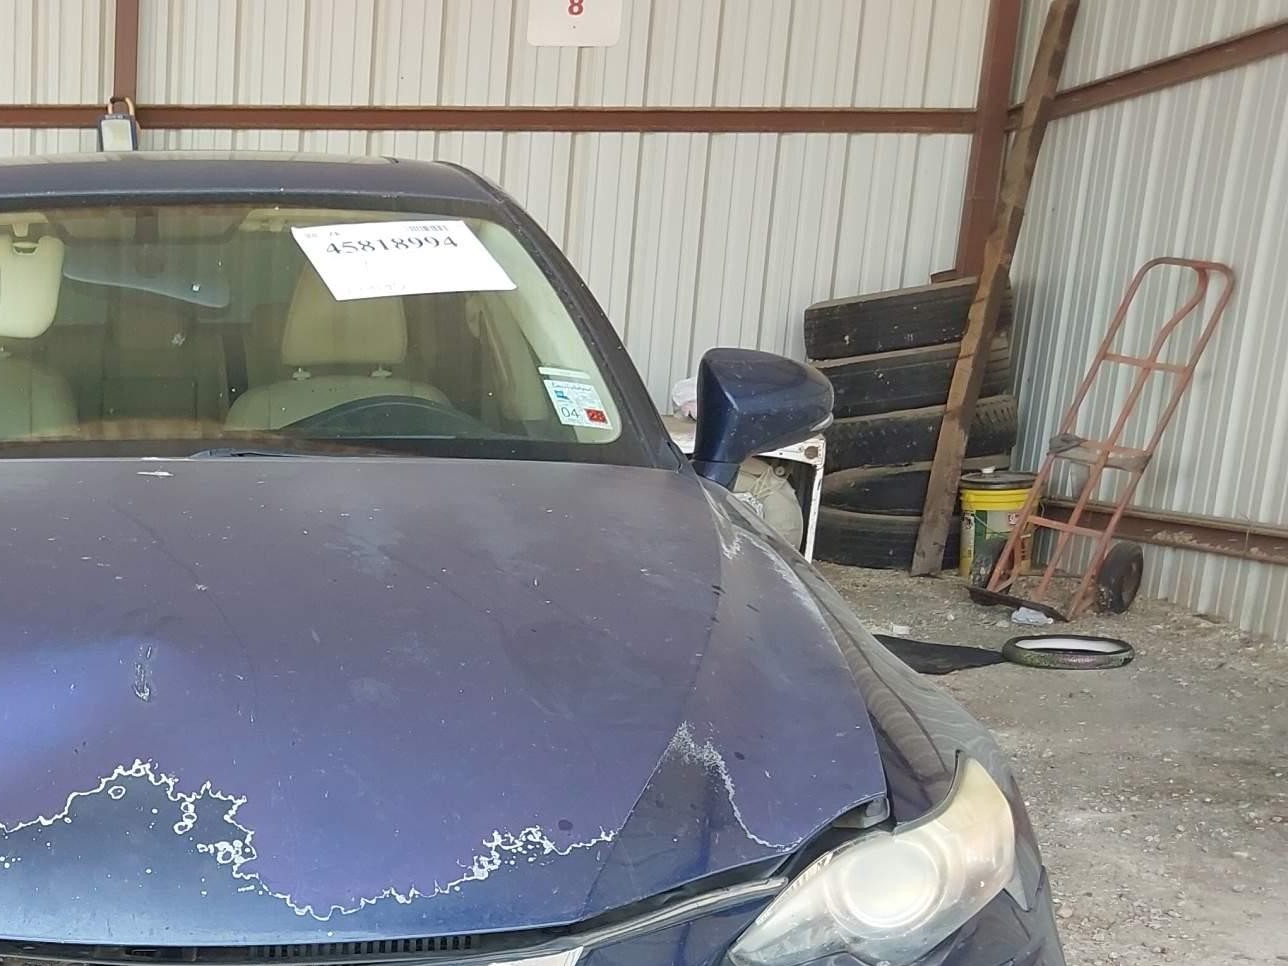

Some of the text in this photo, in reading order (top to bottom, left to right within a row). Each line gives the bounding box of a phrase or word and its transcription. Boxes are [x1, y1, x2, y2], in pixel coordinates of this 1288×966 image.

[568, 0, 583, 15] 8
[326, 235, 458, 254] 45818994
[561, 406, 580, 419] 04
